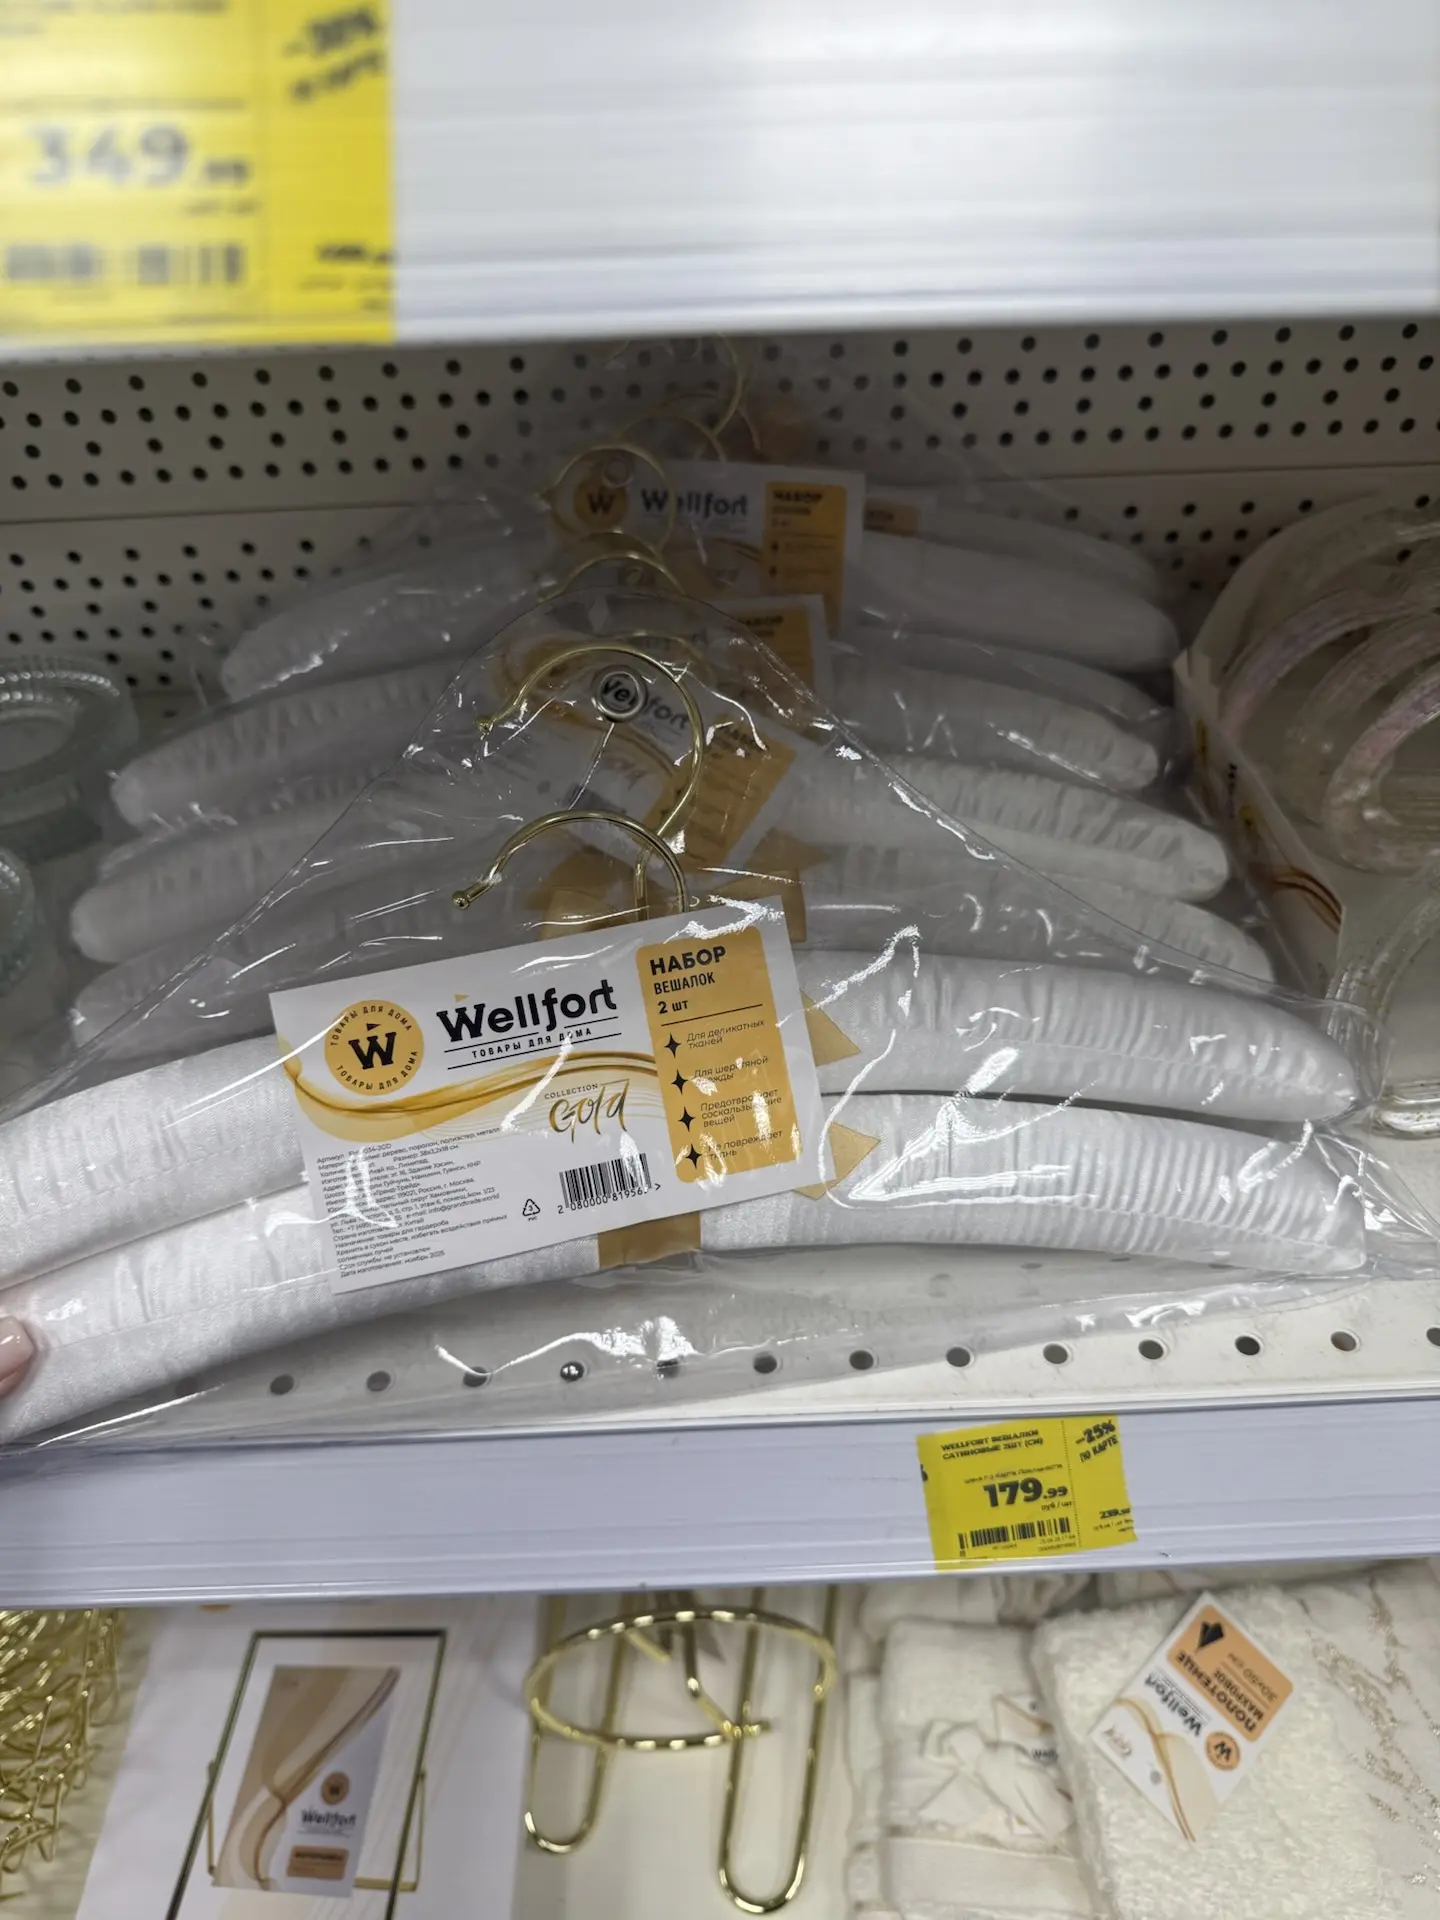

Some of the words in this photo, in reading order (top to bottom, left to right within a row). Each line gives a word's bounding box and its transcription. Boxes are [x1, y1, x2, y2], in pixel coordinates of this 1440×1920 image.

[641, 489, 747, 517] Wllfort
[650, 945, 727, 977] НАБОР
[653, 971, 716, 995] ВЕШАЛОК
[436, 979, 617, 1043] Wellfort
[658, 1000, 668, 1015] 2
[671, 1000, 689, 1013] шт
[330, 1010, 359, 1047] ТОВАРЫ
[362, 1005, 384, 1014] ДЛЯ
[387, 1008, 413, 1031] ДОМА
[708, 1019, 766, 1039] деликатных
[348, 1031, 397, 1070] W
[471, 1042, 521, 1059] ТОВАРЫ
[529, 1035, 552, 1047] ДЛЯ
[558, 1027, 592, 1042] ДОМА
[687, 1035, 724, 1050] тканей
[336, 1064, 373, 1090] ТОВАРЫ
[379, 1077, 399, 1090] ДЛЯ
[400, 1051, 418, 1078] ДОМА
[544, 1082, 599, 1100] COLLECTION
[549, 1080, 630, 1141] Gold
[556, 1204, 564, 1214] 2
[569, 1193, 609, 1211] 080000
[611, 1185, 649, 1201] 81956
[1093, 1435, 1119, 1457] КАРТЕ
[983, 1477, 1068, 1508] 179.99
